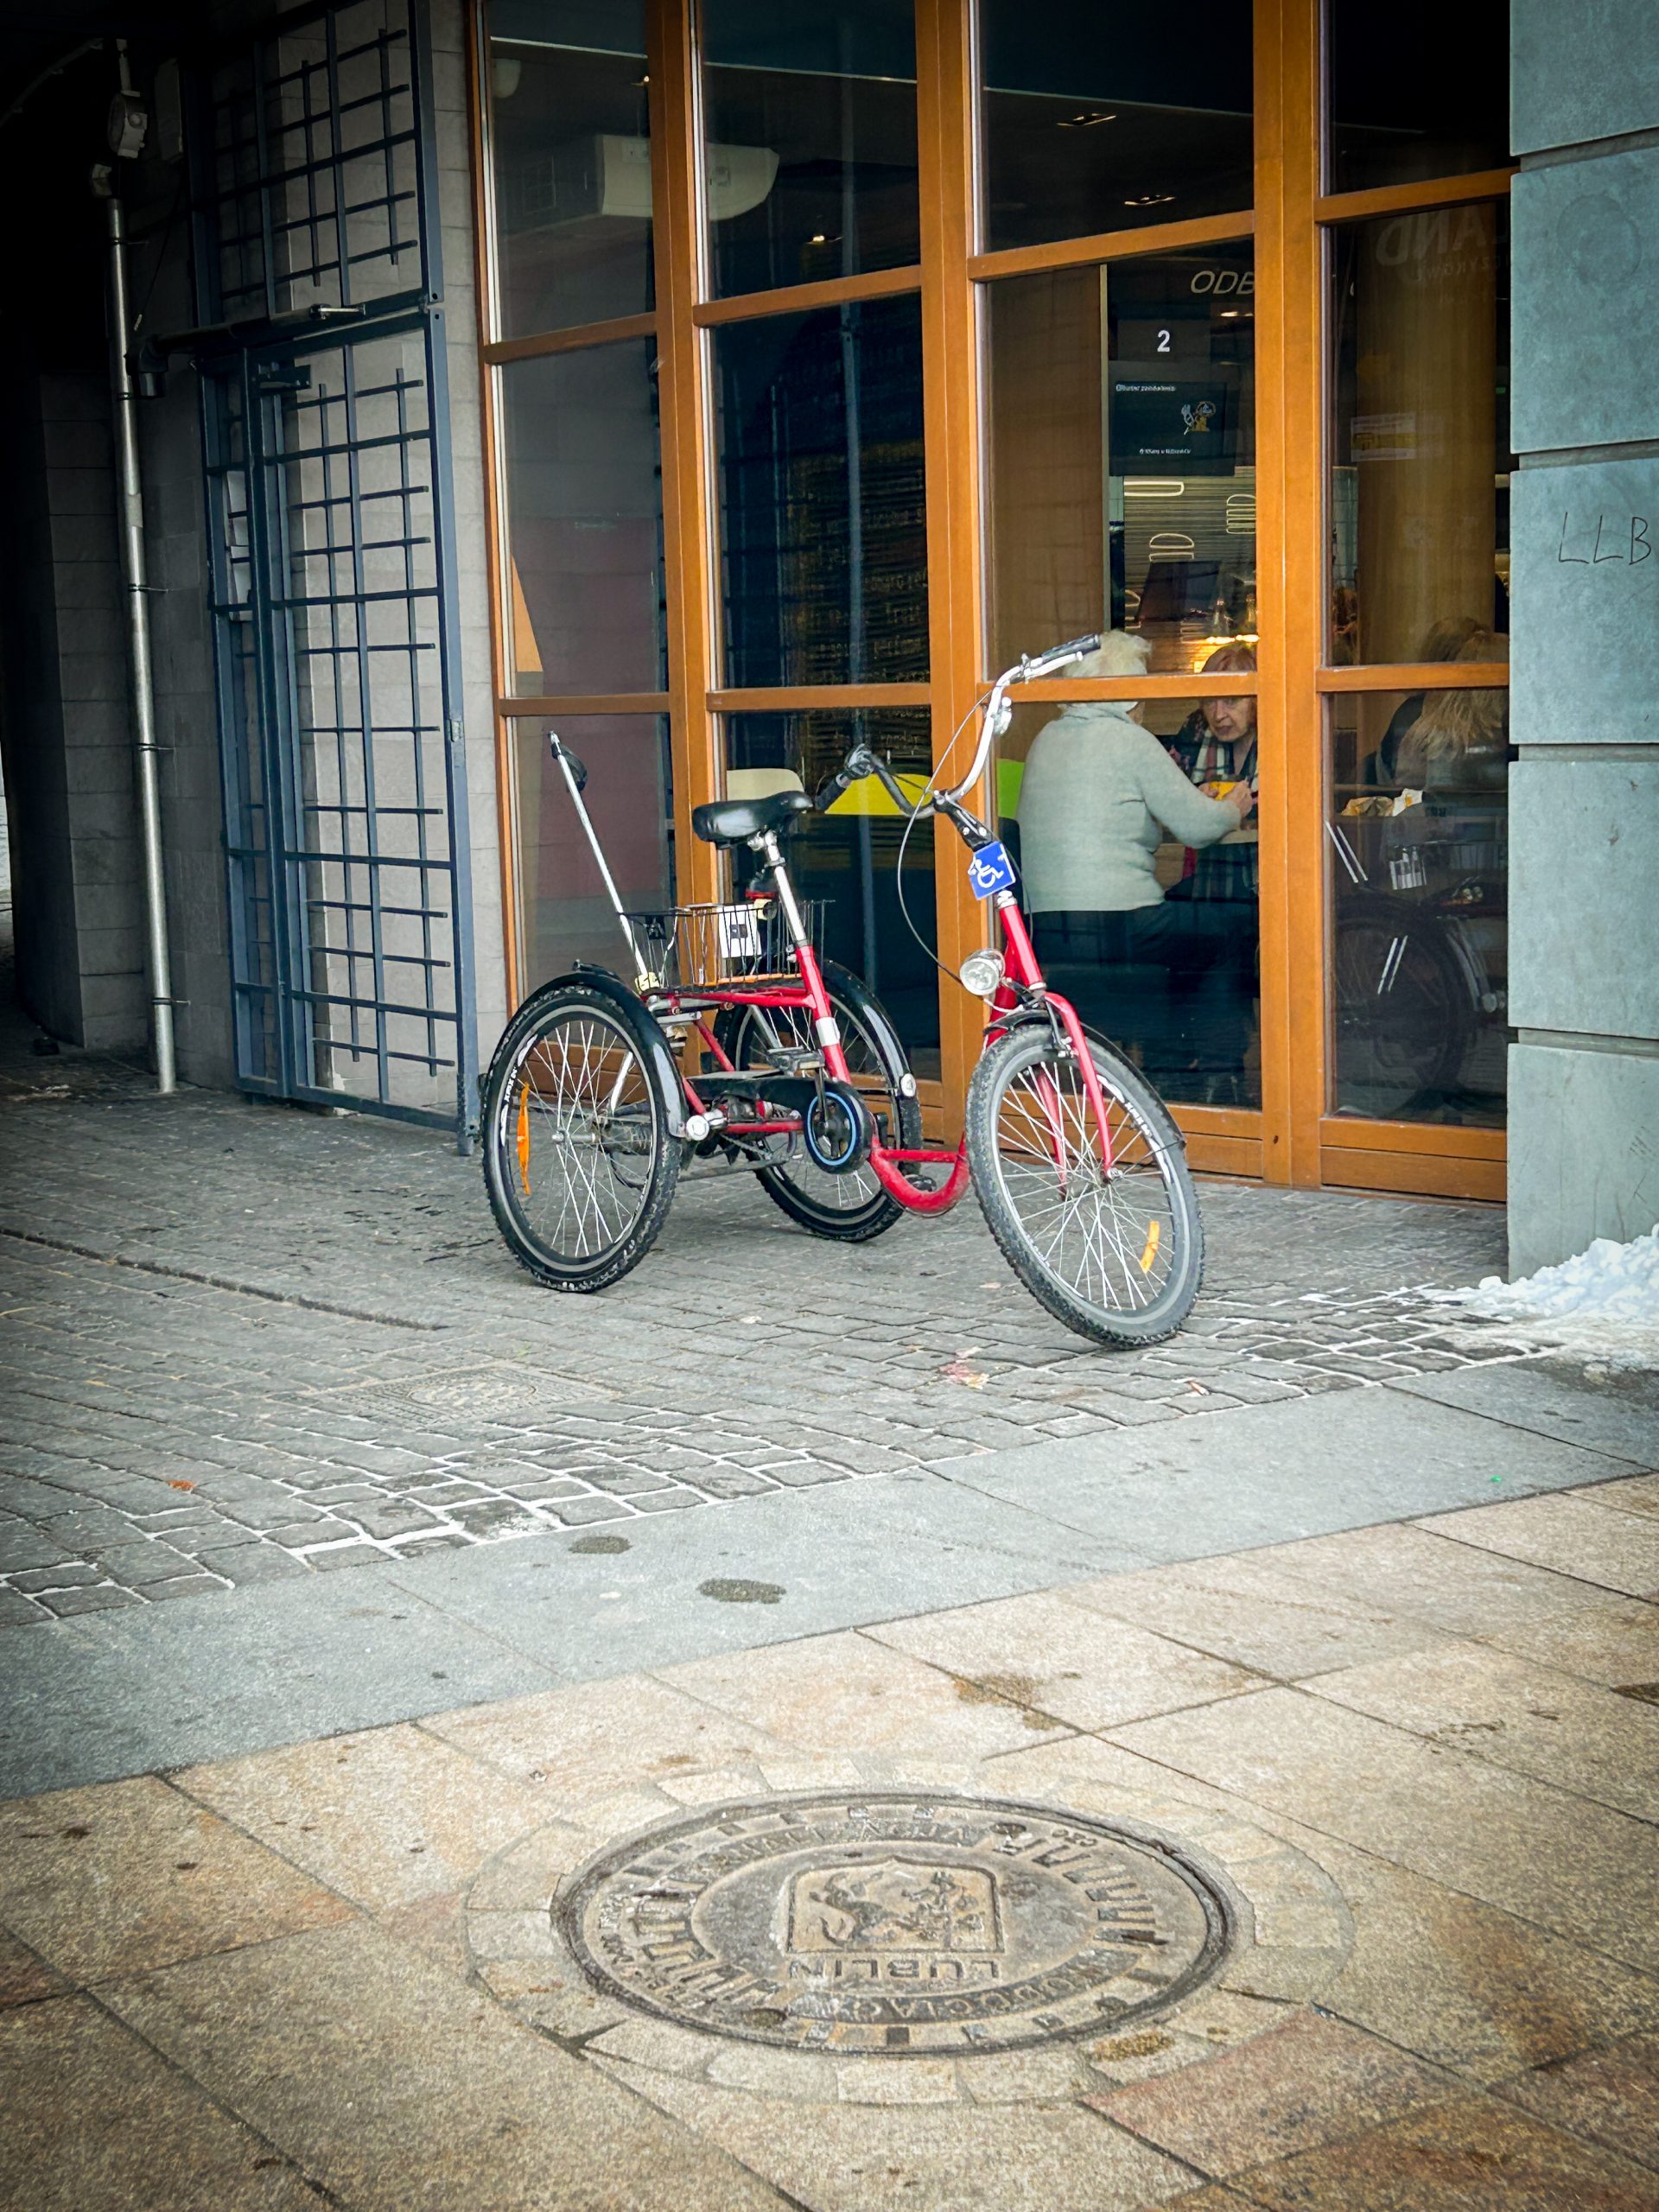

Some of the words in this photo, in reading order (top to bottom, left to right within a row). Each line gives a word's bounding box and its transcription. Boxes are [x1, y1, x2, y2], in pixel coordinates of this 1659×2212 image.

[1156, 330, 1171, 353] 2
[1558, 512, 1651, 566] LLB
[788, 1959, 1001, 1980] LUBLIN
